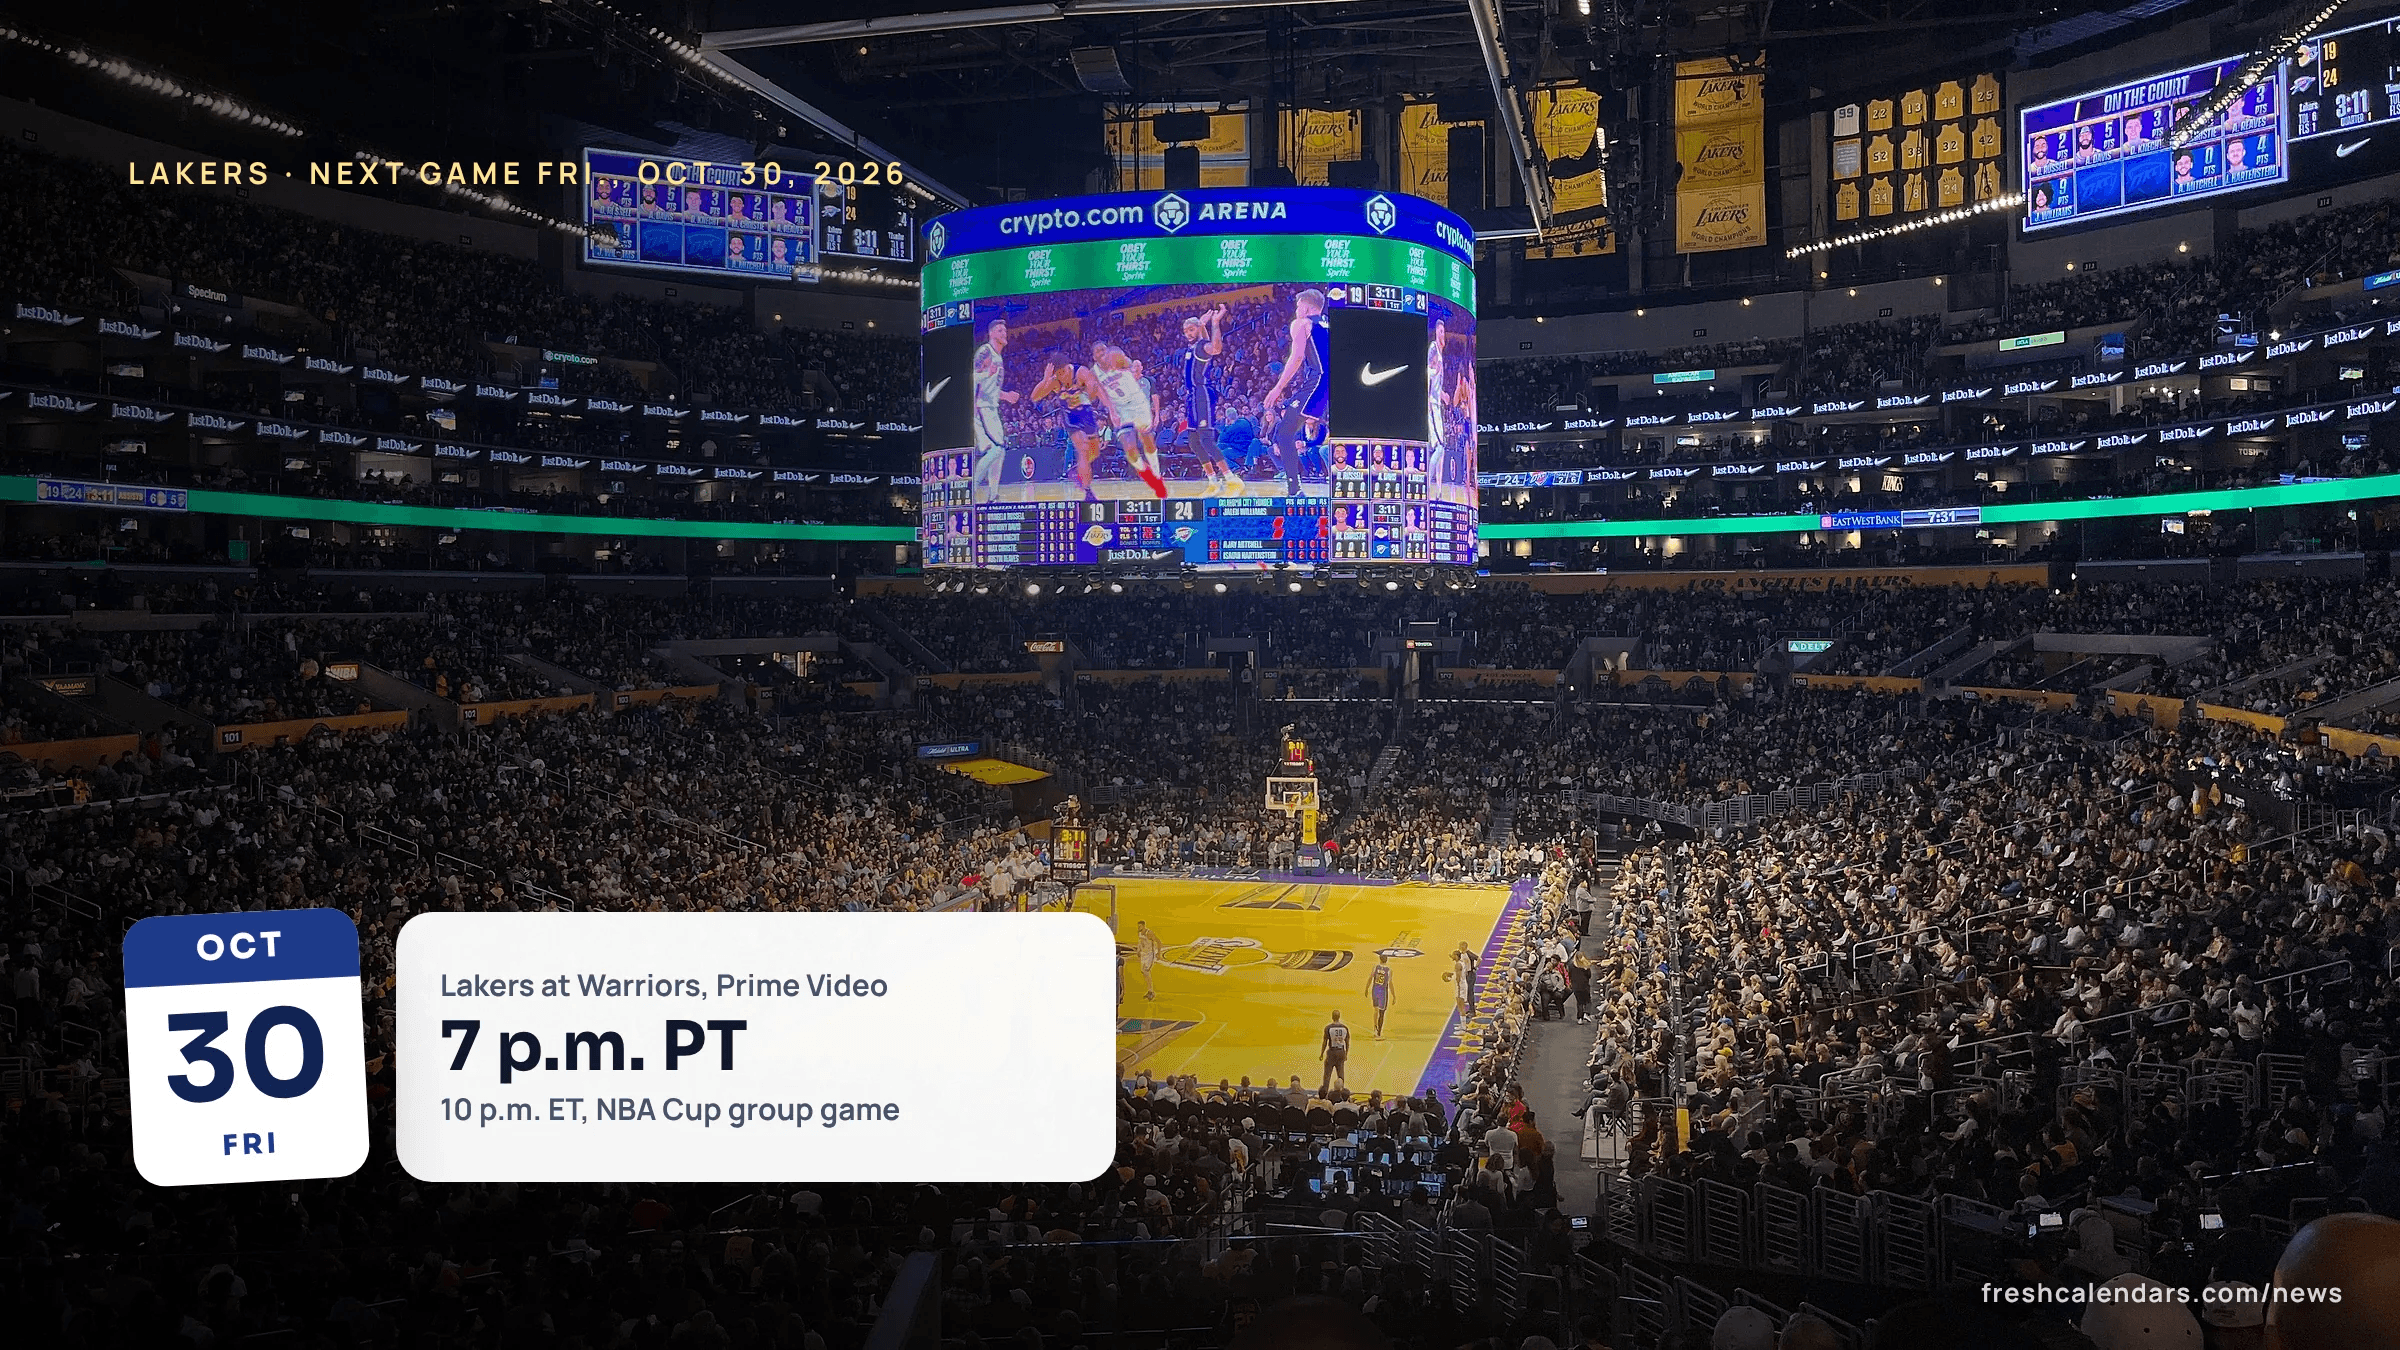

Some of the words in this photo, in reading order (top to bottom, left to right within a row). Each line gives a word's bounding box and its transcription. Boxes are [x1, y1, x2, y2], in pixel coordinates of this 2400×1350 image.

[2323, 41, 2337, 61] 19
[2323, 68, 2338, 88] 24
[1978, 90, 1994, 102] 25
[2104, 92, 2123, 113] ON
[2124, 86, 2146, 109] THE
[2148, 75, 2190, 103] COURT
[2256, 85, 2266, 103] 3
[1941, 96, 1957, 108] 44
[2336, 89, 2369, 118] 3:11
[1839, 108, 1854, 118] 99
[1873, 109, 1887, 119] 22
[1907, 103, 1922, 114] 13
[2255, 104, 2267, 115] PTS
[2154, 110, 2162, 127] 3
[2105, 121, 2113, 138] 5
[1979, 134, 1993, 145] 42
[2058, 133, 2067, 149] 2
[2103, 139, 2115, 149] PTS
[2257, 135, 2267, 153] 4
[1943, 141, 1957, 151] 32
[1692, 145, 1745, 164] LAKERS
[1873, 151, 1888, 162] 52
[2057, 150, 2068, 159] PTS
[2205, 146, 2214, 164] 0
[2256, 154, 2268, 165] PTS
[2204, 165, 2216, 175] PTS
[1944, 184, 1957, 194] 24
[2059, 179, 2067, 195] 9
[2058, 195, 2069, 205] PTS
[845, 206, 857, 221] 24
[1198, 202, 1287, 220] ARENA
[1000, 205, 1143, 235] crypto.com
[1692, 208, 1749, 228] LAKERS
[1691, 231, 1713, 243] WORLD
[1714, 225, 1752, 242] CHAMPIONS
[1120, 243, 1147, 254] OBEY
[1220, 239, 1248, 250] OBEY
[1324, 239, 1351, 250] OBEY
[1116, 260, 1151, 272] THIRST
[1217, 257, 1252, 269] THIRST
[1320, 256, 1355, 269] THIRST
[1122, 270, 1146, 282] Sprite
[1222, 267, 1247, 278] Sprite
[1326, 267, 1351, 278] Sprite
[188, 284, 227, 303] Spectrum
[1350, 286, 1362, 303] 19
[1375, 286, 1396, 299] 3:11
[1504, 475, 1519, 485] 24
[1089, 503, 1104, 521] 19
[1126, 501, 1152, 512] 3:11
[1175, 502, 1193, 520] 24
[1378, 505, 1396, 514] 3:11
[1832, 516, 1853, 527] EAST
[1854, 516, 1876, 527] WEST
[1876, 514, 1900, 525] BANK
[1928, 511, 1956, 523] 7:31
[224, 732, 240, 743] 101
